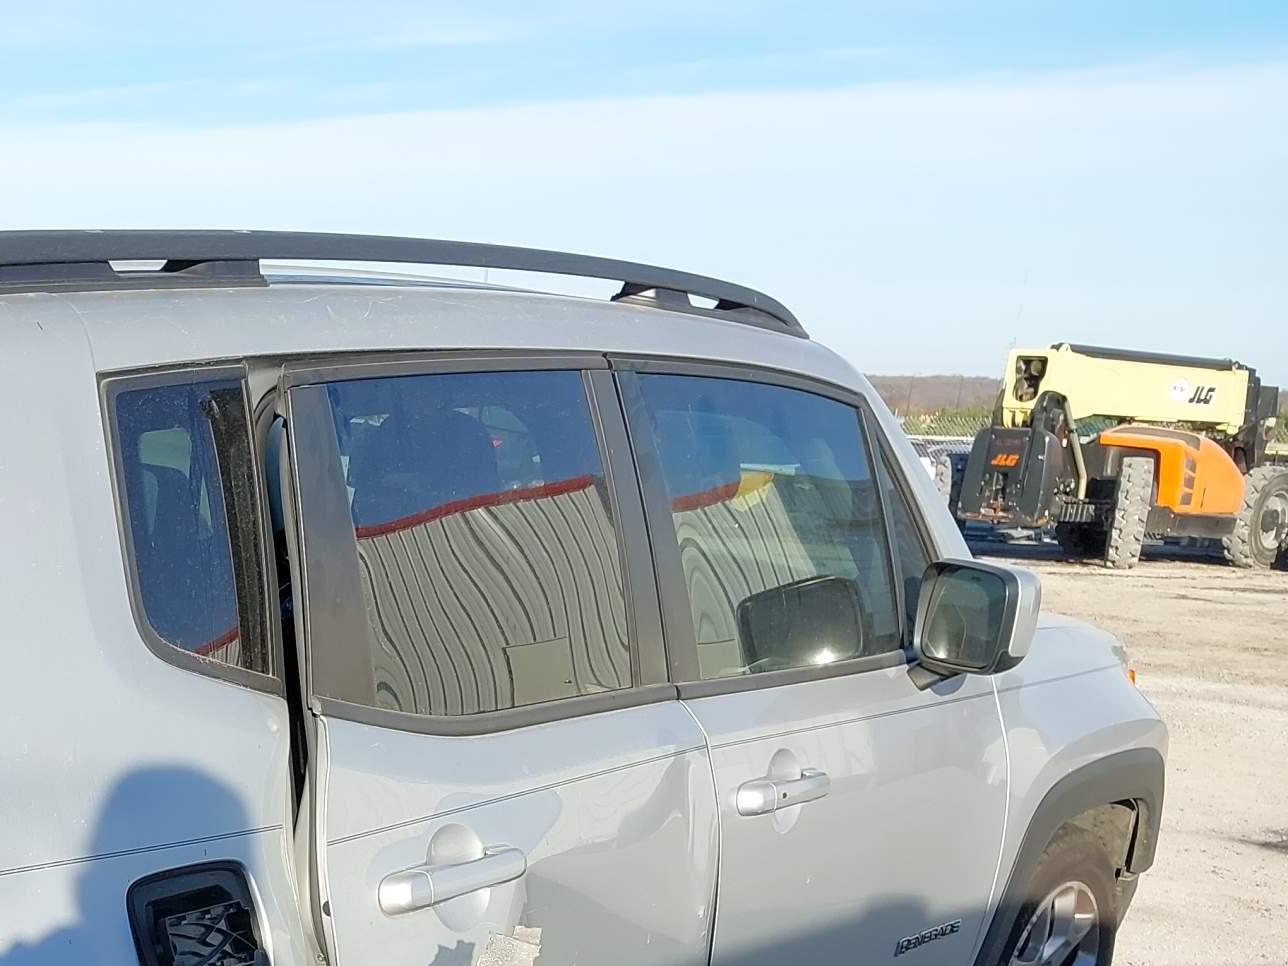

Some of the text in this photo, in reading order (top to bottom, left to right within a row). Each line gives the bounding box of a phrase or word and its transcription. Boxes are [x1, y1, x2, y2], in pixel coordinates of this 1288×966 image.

[1188, 386, 1216, 405] JLG
[990, 453, 1020, 467] JLG
[893, 918, 962, 958] RENEGADE
